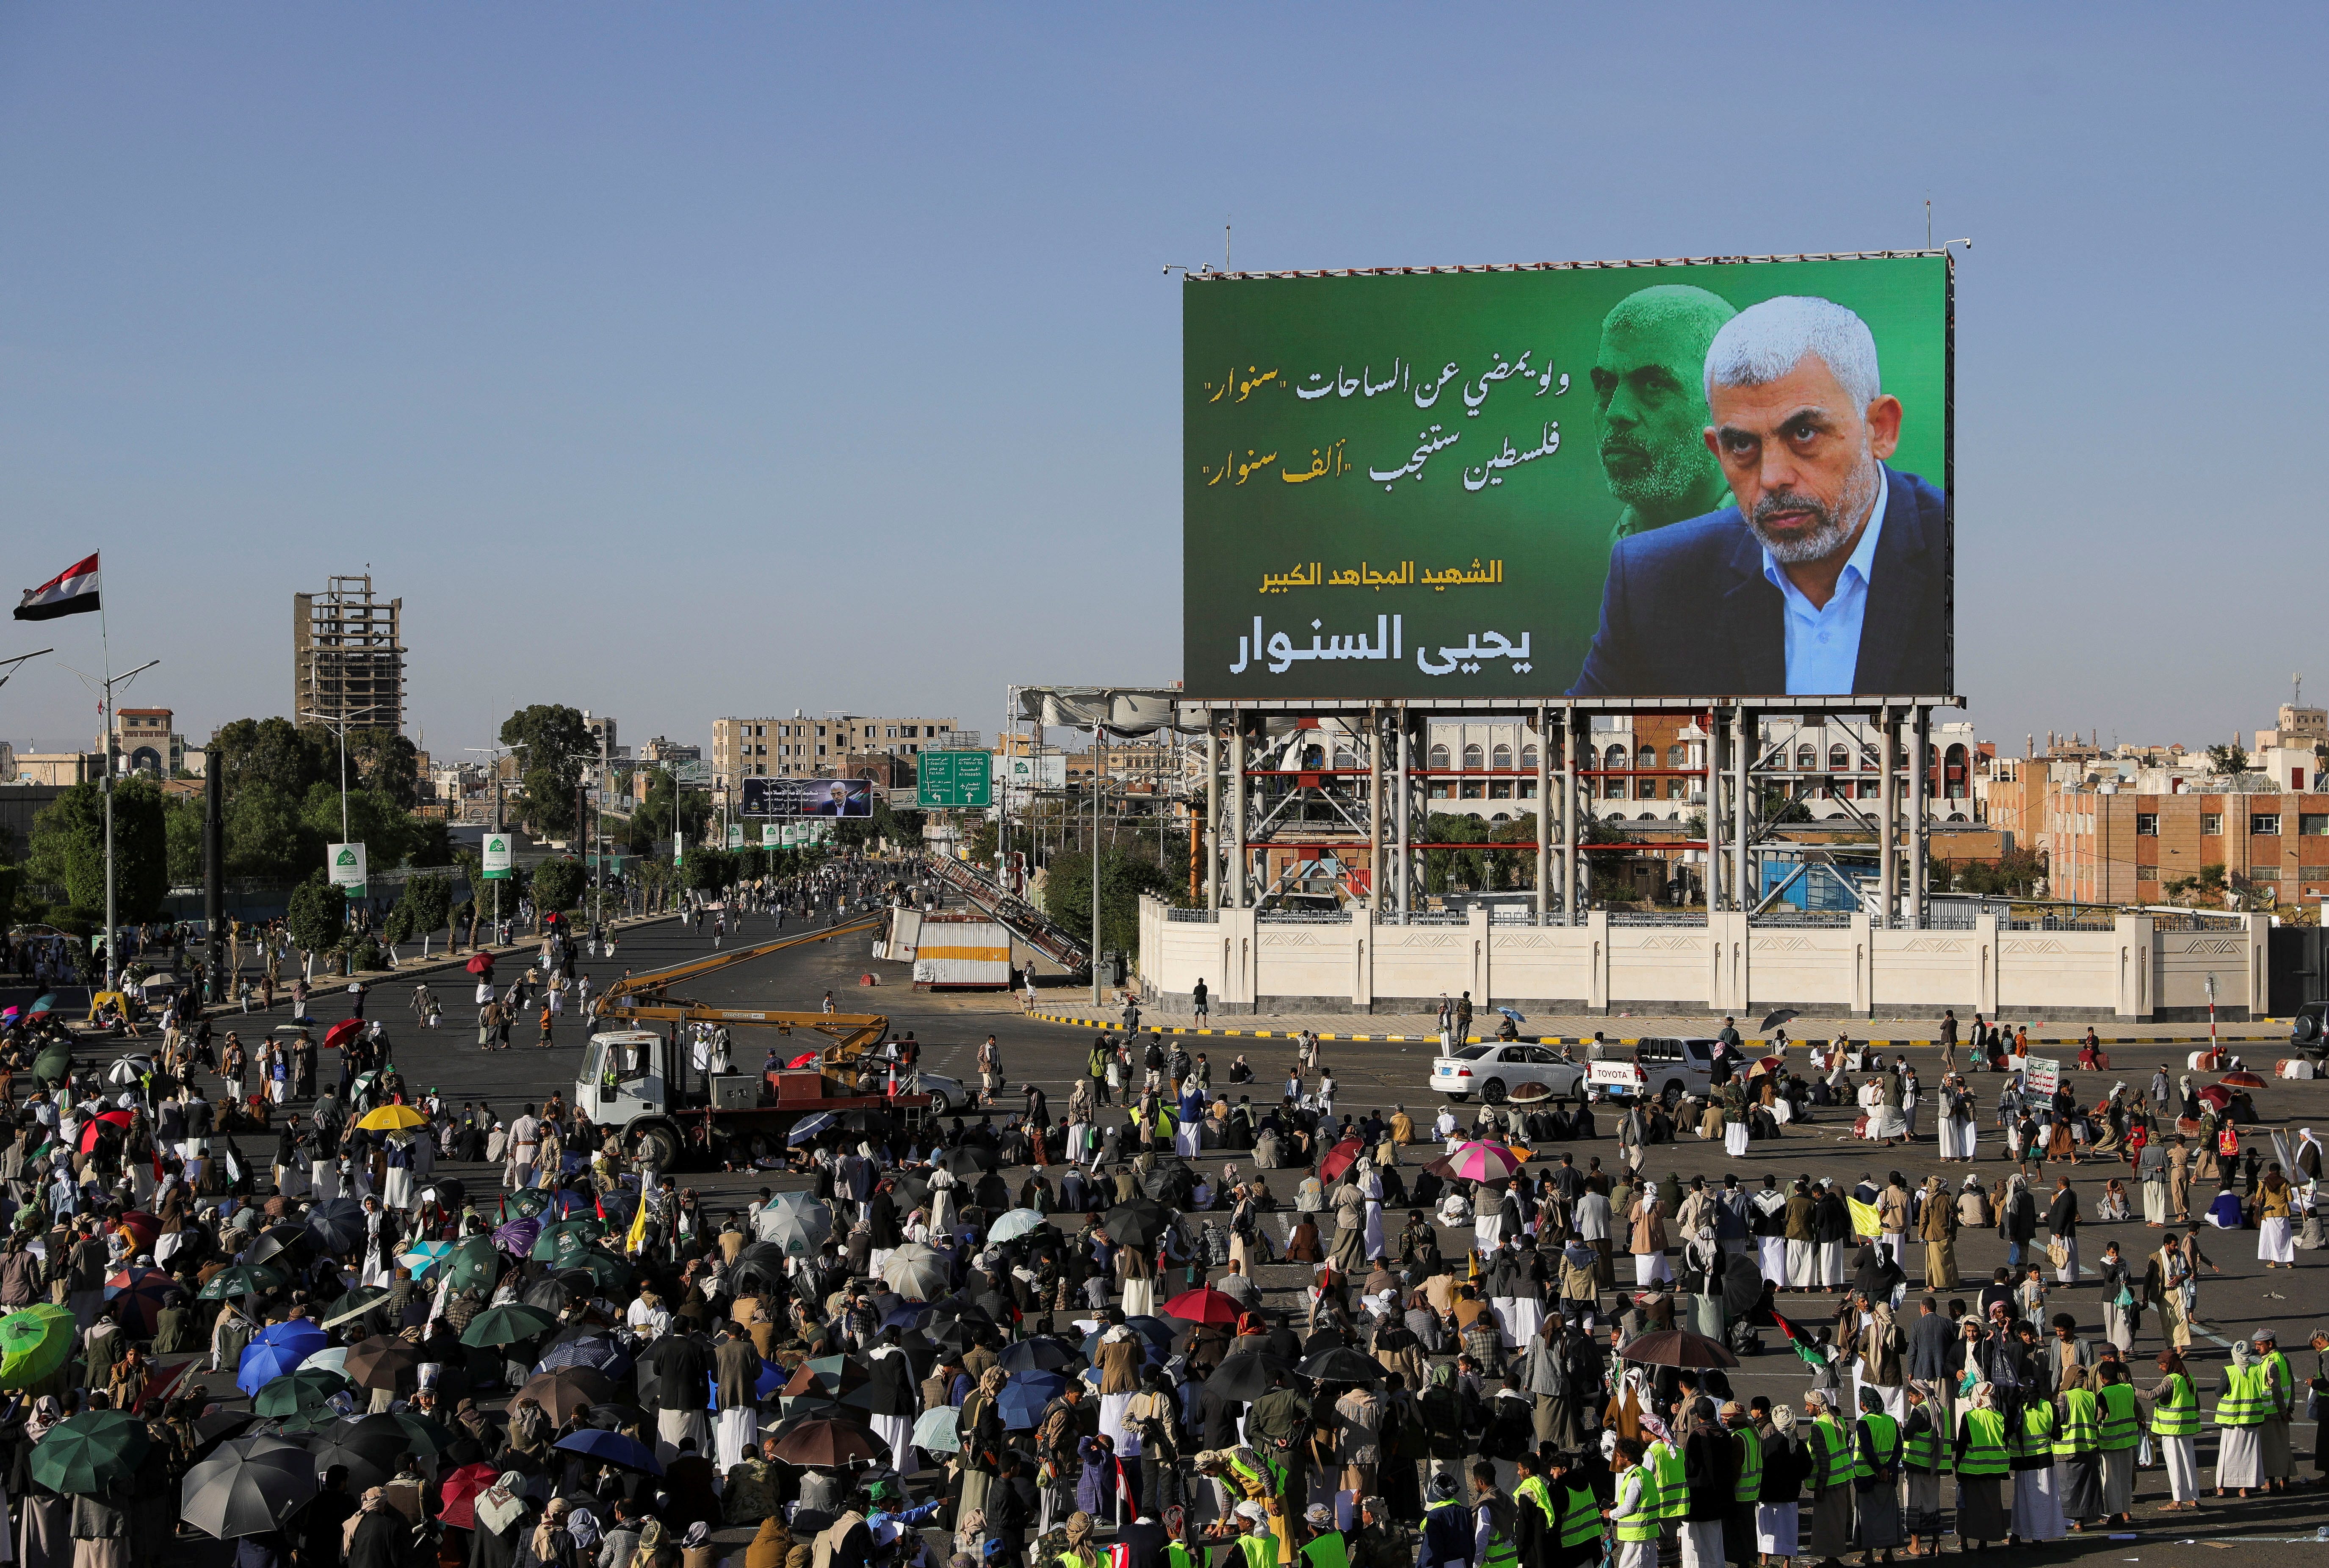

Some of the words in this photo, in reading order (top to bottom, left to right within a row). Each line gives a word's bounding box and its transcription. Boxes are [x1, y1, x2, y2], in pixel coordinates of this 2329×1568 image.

[1296, 357, 1409, 400] الساحات
[1415, 362, 1459, 408] عن
[1463, 350, 1536, 416] يمضي
[1369, 424, 1460, 492] ستنجب
[1463, 421, 1560, 491] فلسطين
[1259, 562, 1321, 593] الكبير
[1328, 560, 1414, 591] المجاهد
[1421, 558, 1502, 591] الشهيد
[1229, 614, 1402, 674] السنوار
[1417, 630, 1533, 676] يحيى
[1597, 1070, 1628, 1079] TOYOTA
[2028, 1062, 2046, 1071] أكبر
[2046, 1064, 2057, 1072] الله
